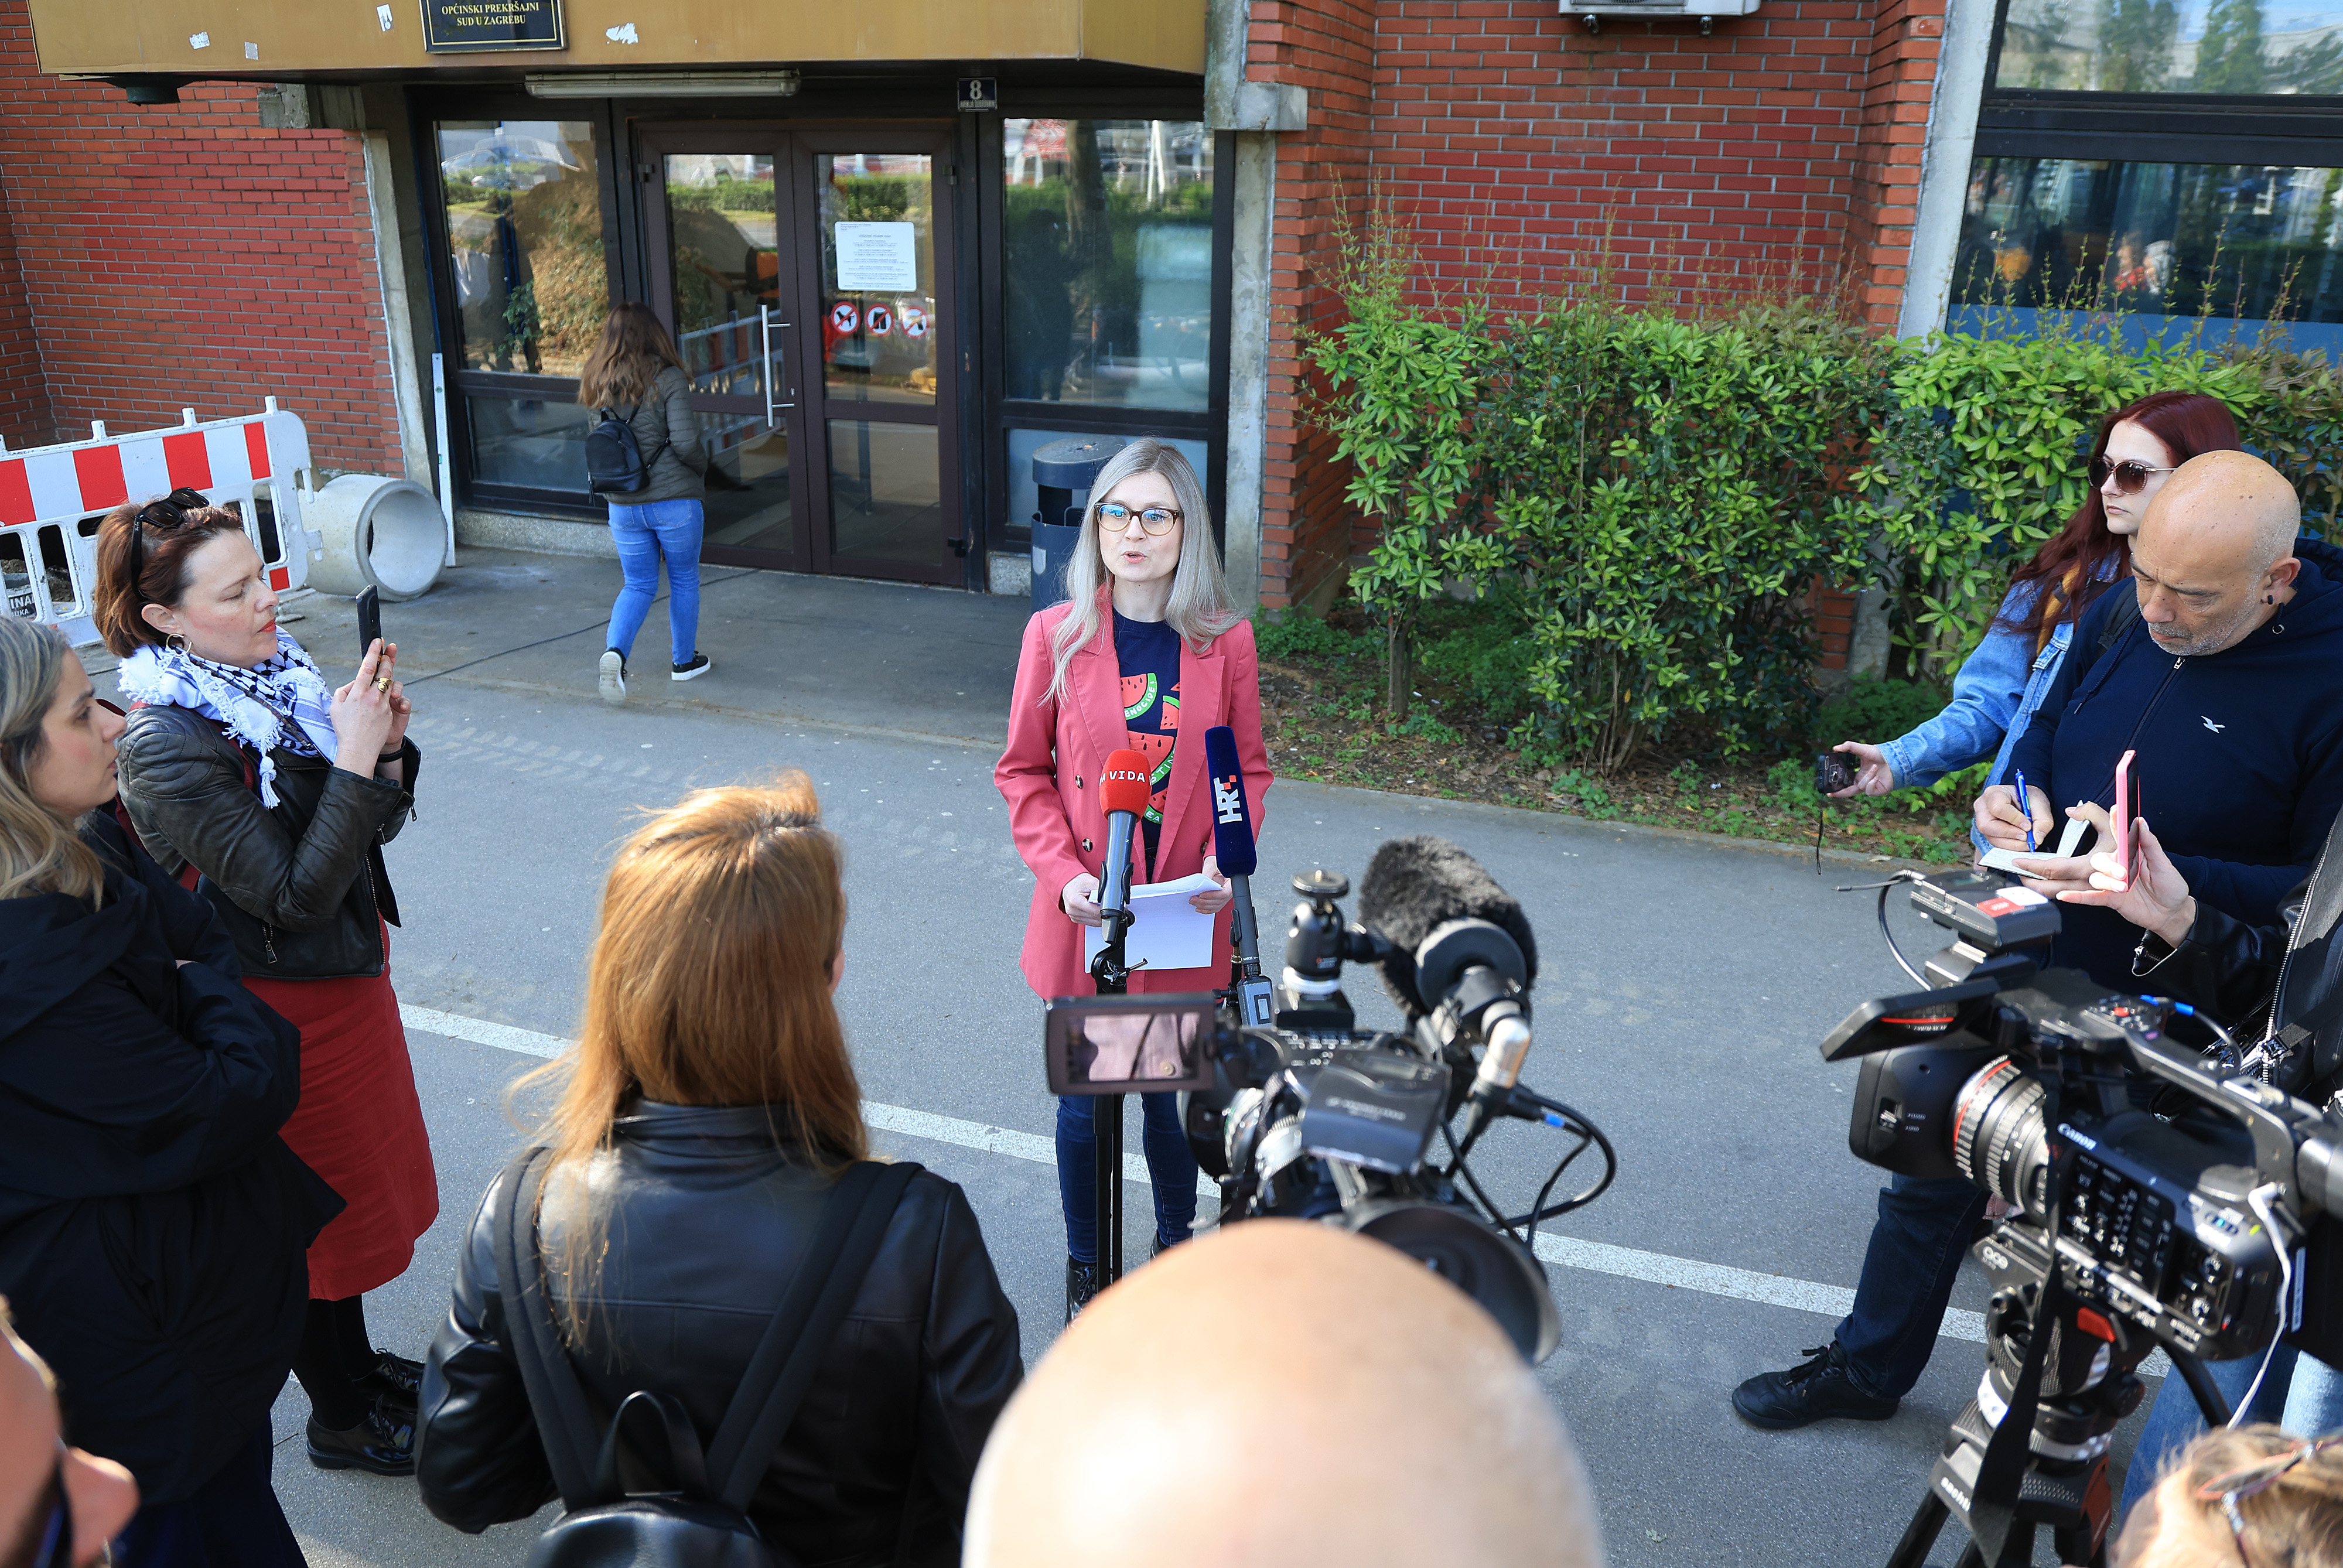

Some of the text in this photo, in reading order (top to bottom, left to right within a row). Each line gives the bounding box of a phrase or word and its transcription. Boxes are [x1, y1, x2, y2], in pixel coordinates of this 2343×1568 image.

[442, 1, 539, 14] OPĆINSKI PREKRŠAJNI
[457, 15, 525, 26] SUD U ZAGREBU
[969, 79, 982, 100] 8
[11, 595, 35, 609] INA
[1123, 681, 1157, 718] ENOCIDE!
[1109, 770, 1146, 783] VIDA
[1213, 777, 1242, 824] HRT
[1146, 810, 1163, 822] EA
